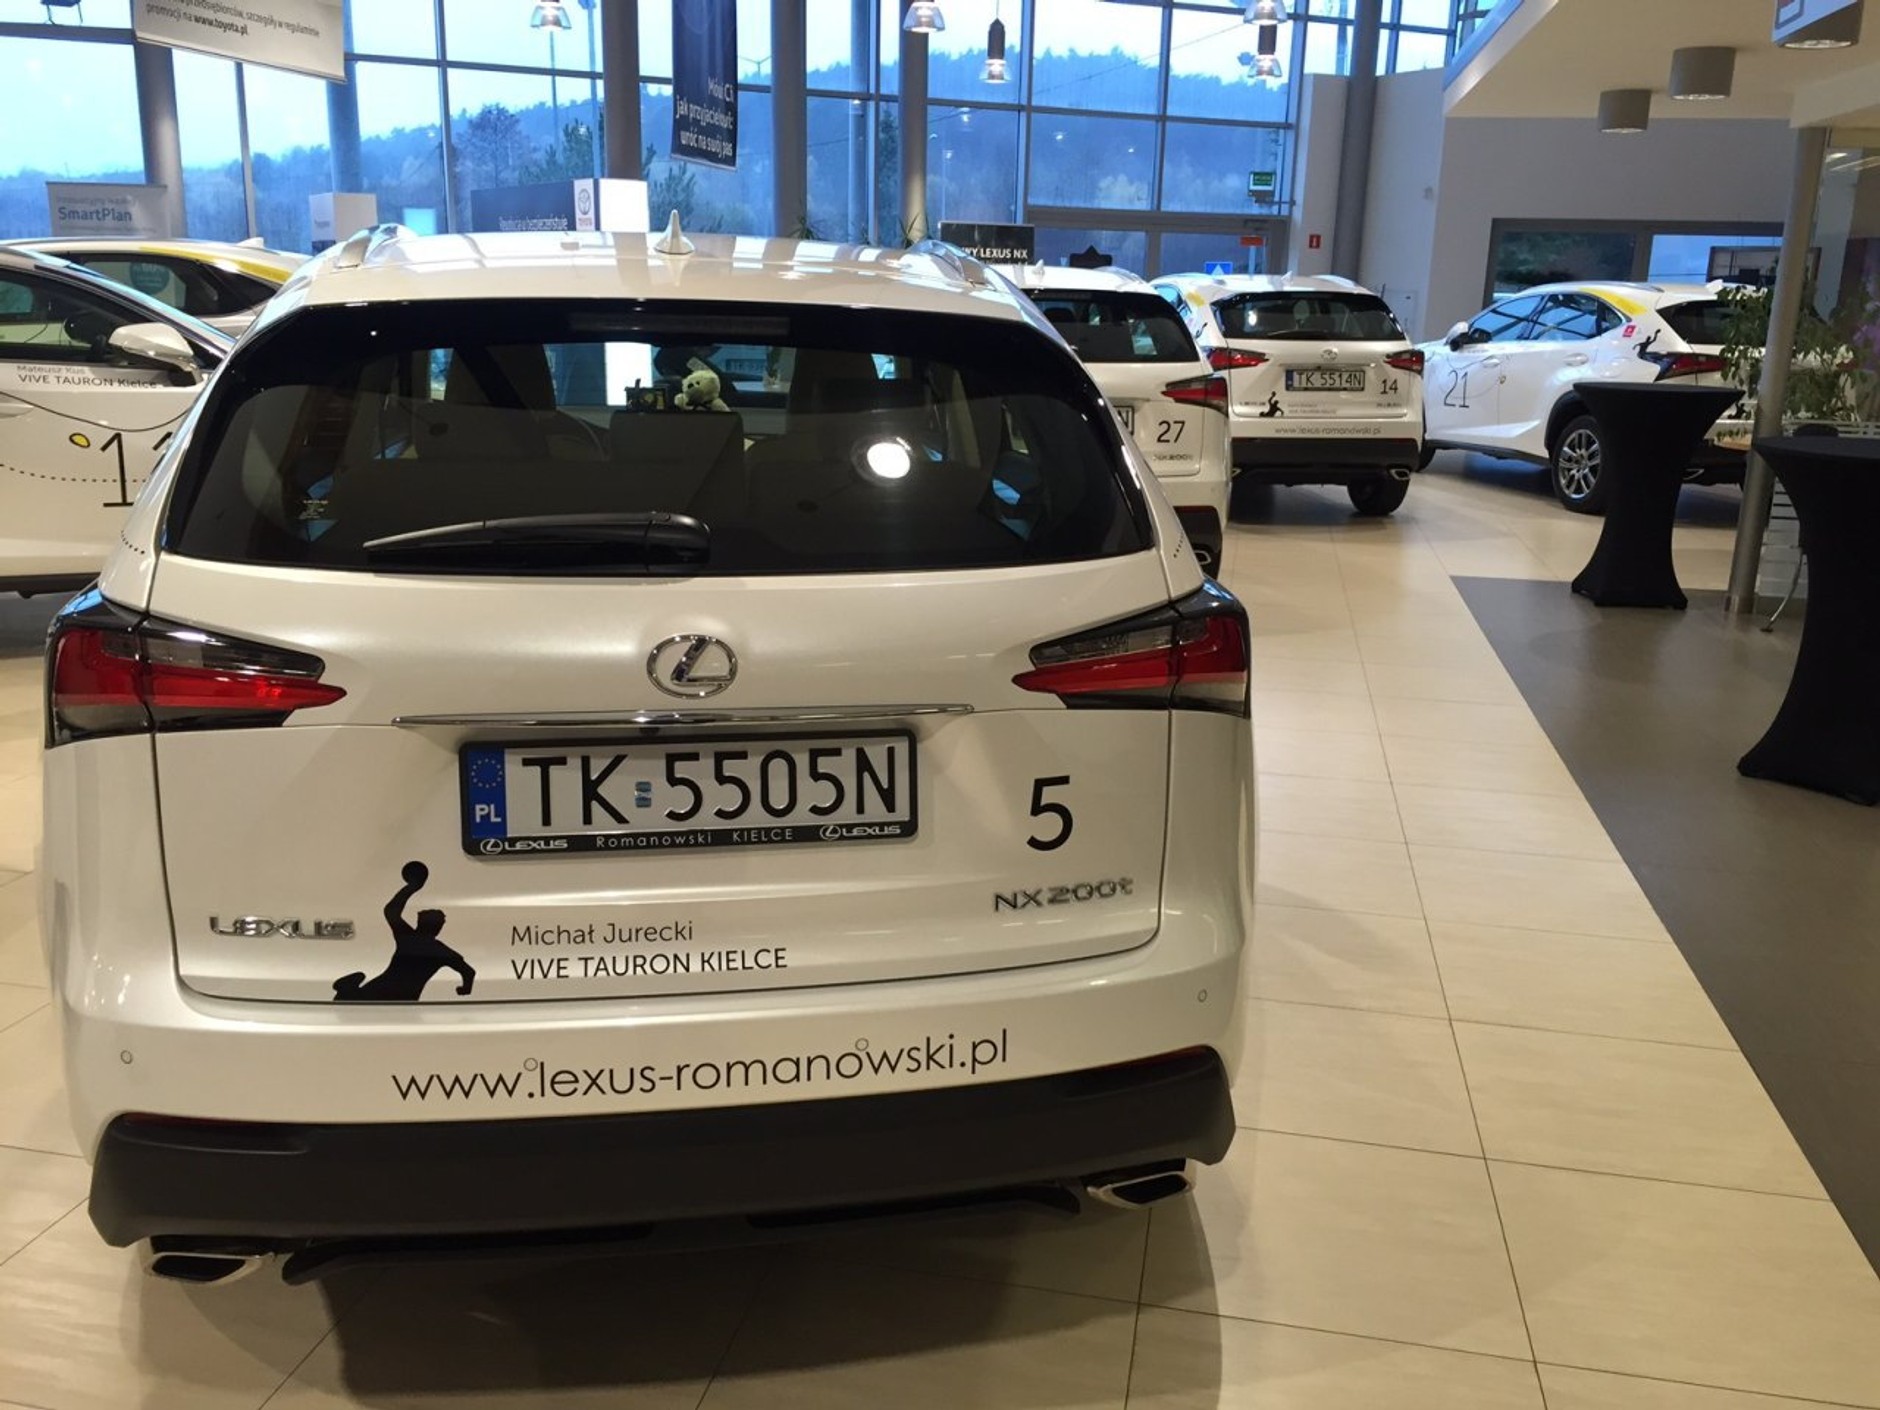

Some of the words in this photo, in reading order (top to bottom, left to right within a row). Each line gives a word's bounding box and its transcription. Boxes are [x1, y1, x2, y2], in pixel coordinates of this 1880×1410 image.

[193, 14, 248, 36] www.toyota.pl
[676, 94, 688, 119] jak
[722, 141, 733, 159] pas
[57, 206, 132, 222] SmartPlan
[980, 247, 1012, 259] LEXUS
[1013, 249, 1028, 259] NX
[18, 374, 51, 384] VIVE
[55, 376, 114, 387] TAURON
[117, 378, 158, 389] Kielce
[1296, 371, 1314, 386] TK
[1320, 371, 1361, 386] 5514N
[1380, 378, 1398, 394] 14
[1443, 369, 1470, 408] 21
[1156, 420, 1185, 443] 27
[100, 431, 173, 507] 1
[521, 753, 630, 827] TK
[664, 745, 897, 822] 5505N
[474, 804, 502, 824] PL
[1026, 775, 1074, 851] 5
[503, 838, 569, 851] LEXUS
[596, 831, 712, 848] Romanowski
[732, 828, 795, 842] KIELCE
[841, 824, 902, 837] LEXUS
[209, 915, 355, 940] LEXUS
[510, 923, 596, 946] Michał
[603, 921, 694, 945] Jurecki
[511, 957, 570, 980] VIVE
[577, 952, 692, 979] TAURON
[700, 947, 788, 974] KIELCE
[392, 1028, 1008, 1101] www.lexus-romanowski.pl
